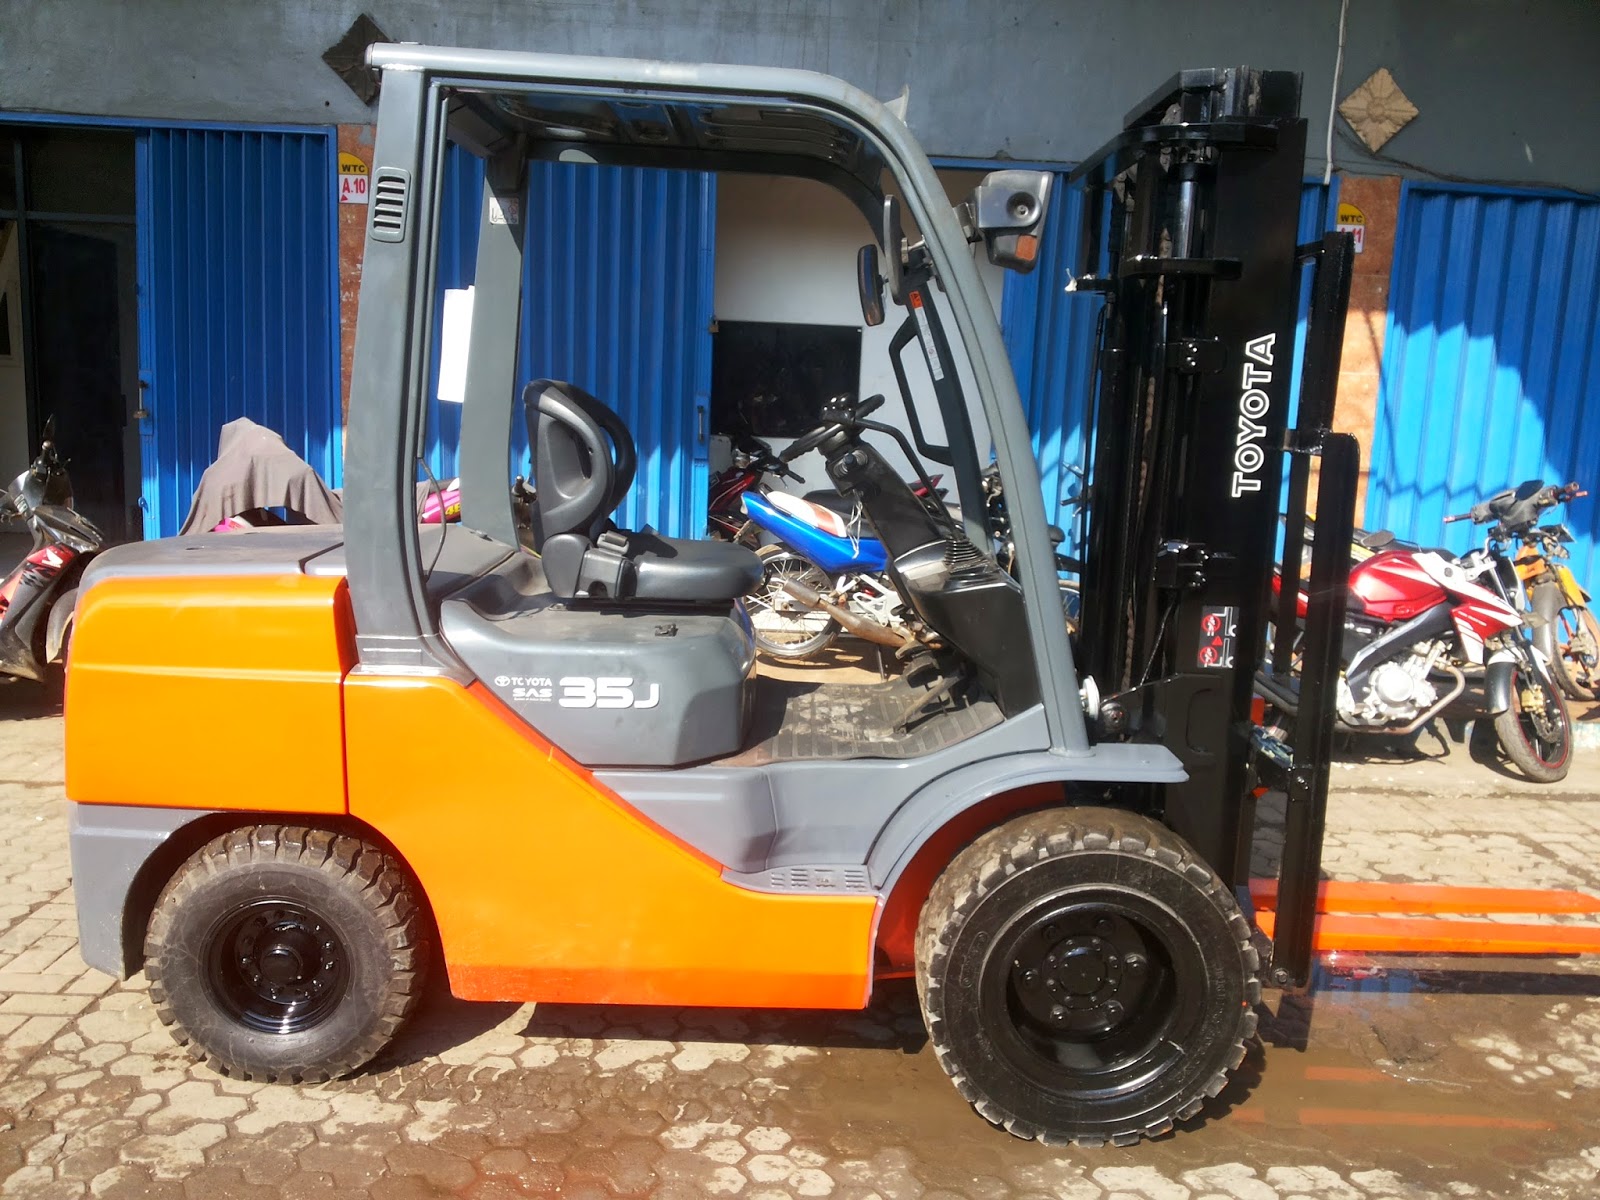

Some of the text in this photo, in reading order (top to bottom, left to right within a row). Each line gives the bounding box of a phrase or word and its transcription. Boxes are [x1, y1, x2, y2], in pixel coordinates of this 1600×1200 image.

[341, 164, 365, 172] WTC
[342, 177, 366, 194] A.10
[1340, 214, 1363, 223] WTC
[1231, 332, 1276, 498] TOYOTA
[512, 687, 553, 698] SAS
[558, 676, 660, 709] 35J
